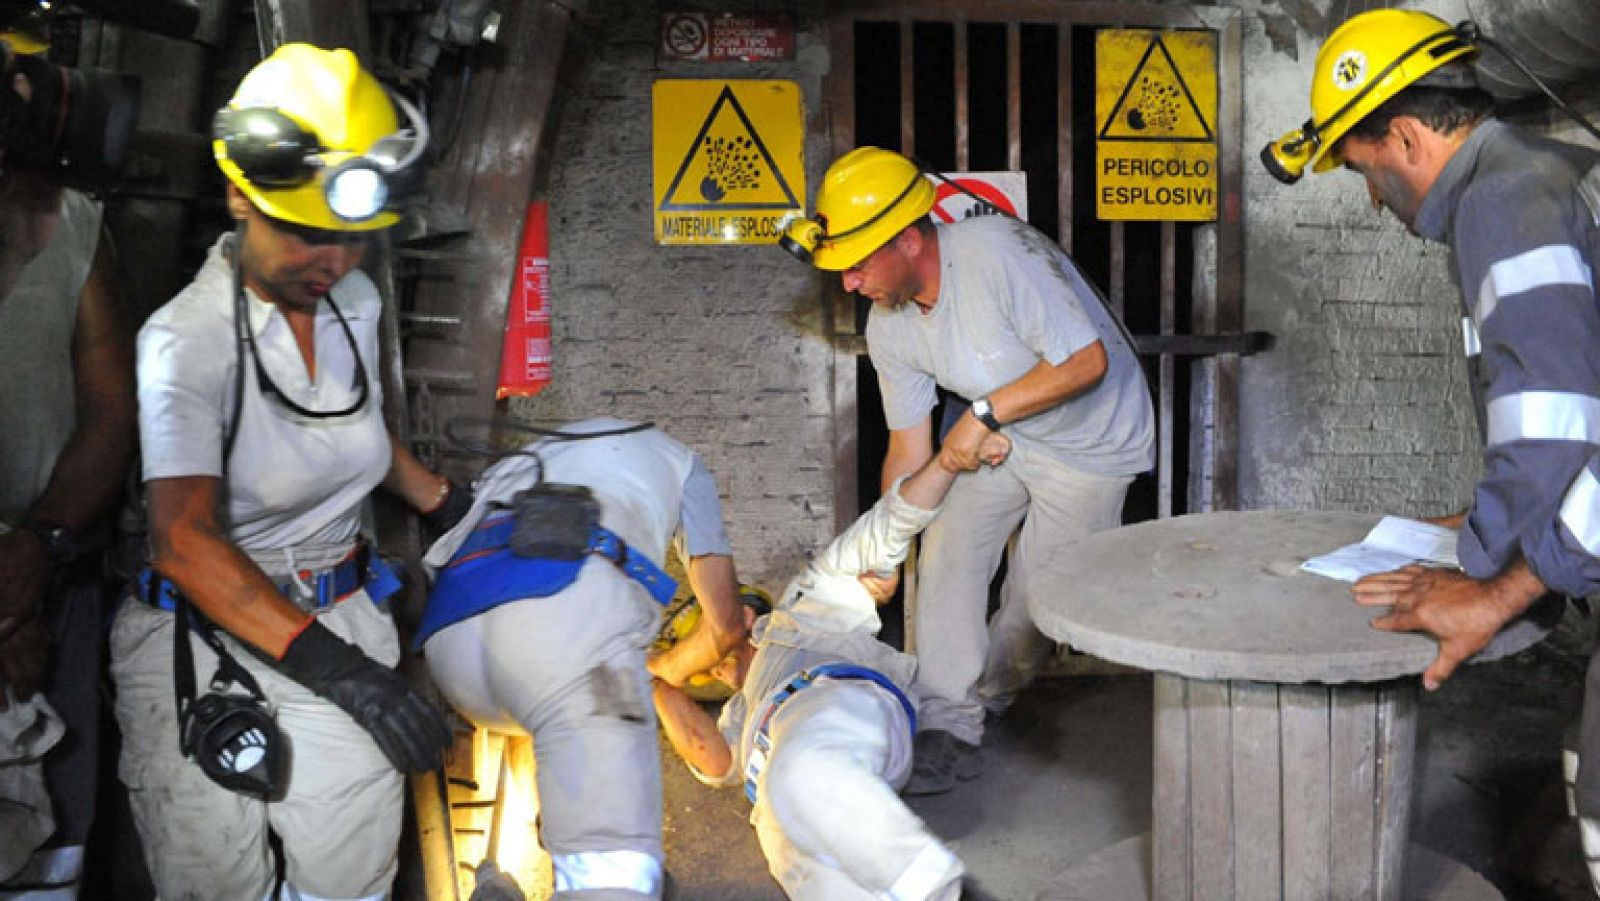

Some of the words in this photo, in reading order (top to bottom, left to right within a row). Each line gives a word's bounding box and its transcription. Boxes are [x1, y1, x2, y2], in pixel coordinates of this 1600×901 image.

[1103, 158, 1209, 177] PERICOLO
[1102, 187, 1211, 205] ESPLOSIVI
[662, 216, 726, 237] MATERIALE
